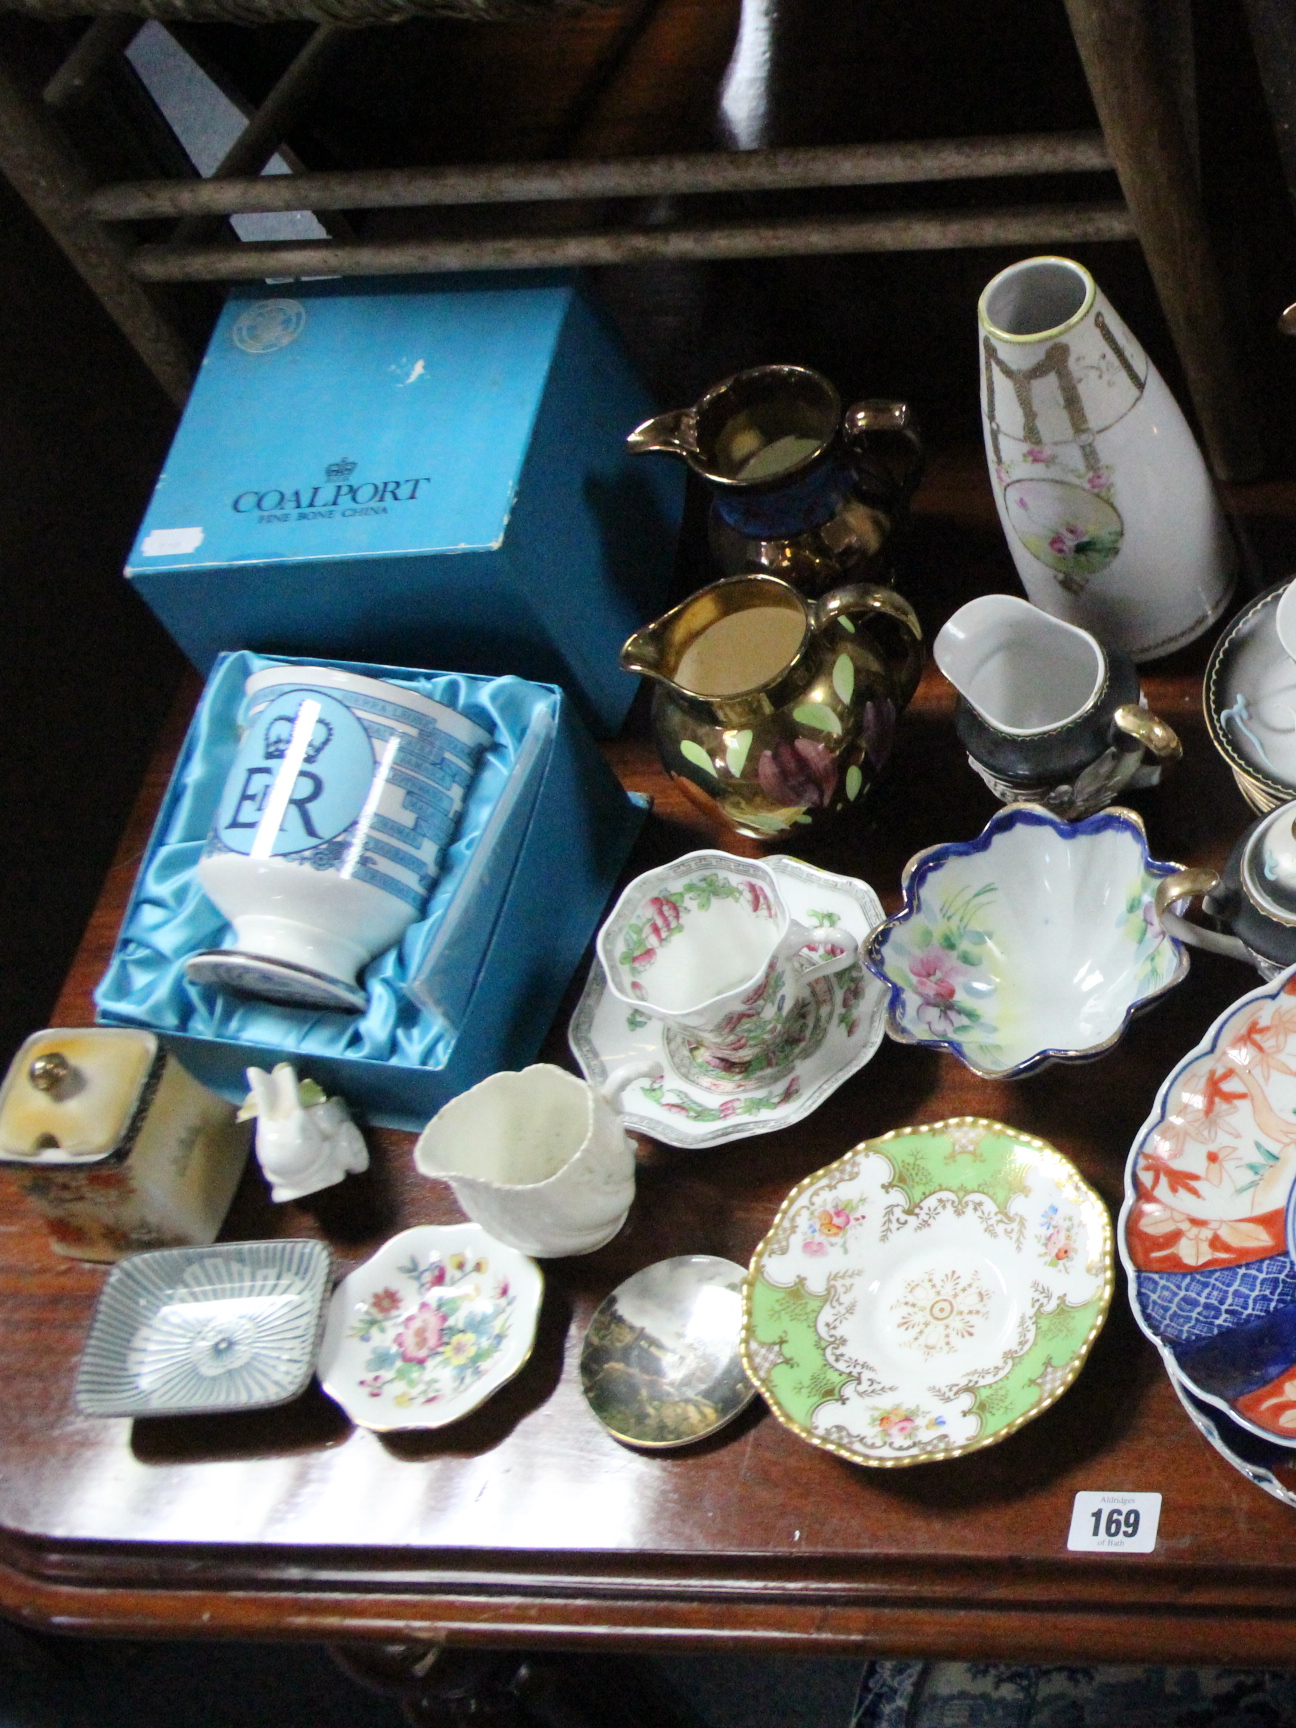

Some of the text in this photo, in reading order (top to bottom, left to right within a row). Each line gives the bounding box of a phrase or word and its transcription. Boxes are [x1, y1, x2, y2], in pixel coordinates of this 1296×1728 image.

[232, 477, 431, 514] COALPORT
[258, 506, 389, 525] FINE BONE CHINA
[1100, 1496, 1136, 1506] Aldridges
[1090, 1508, 1141, 1538] 169
[1097, 1539, 1125, 1547] of Bath
